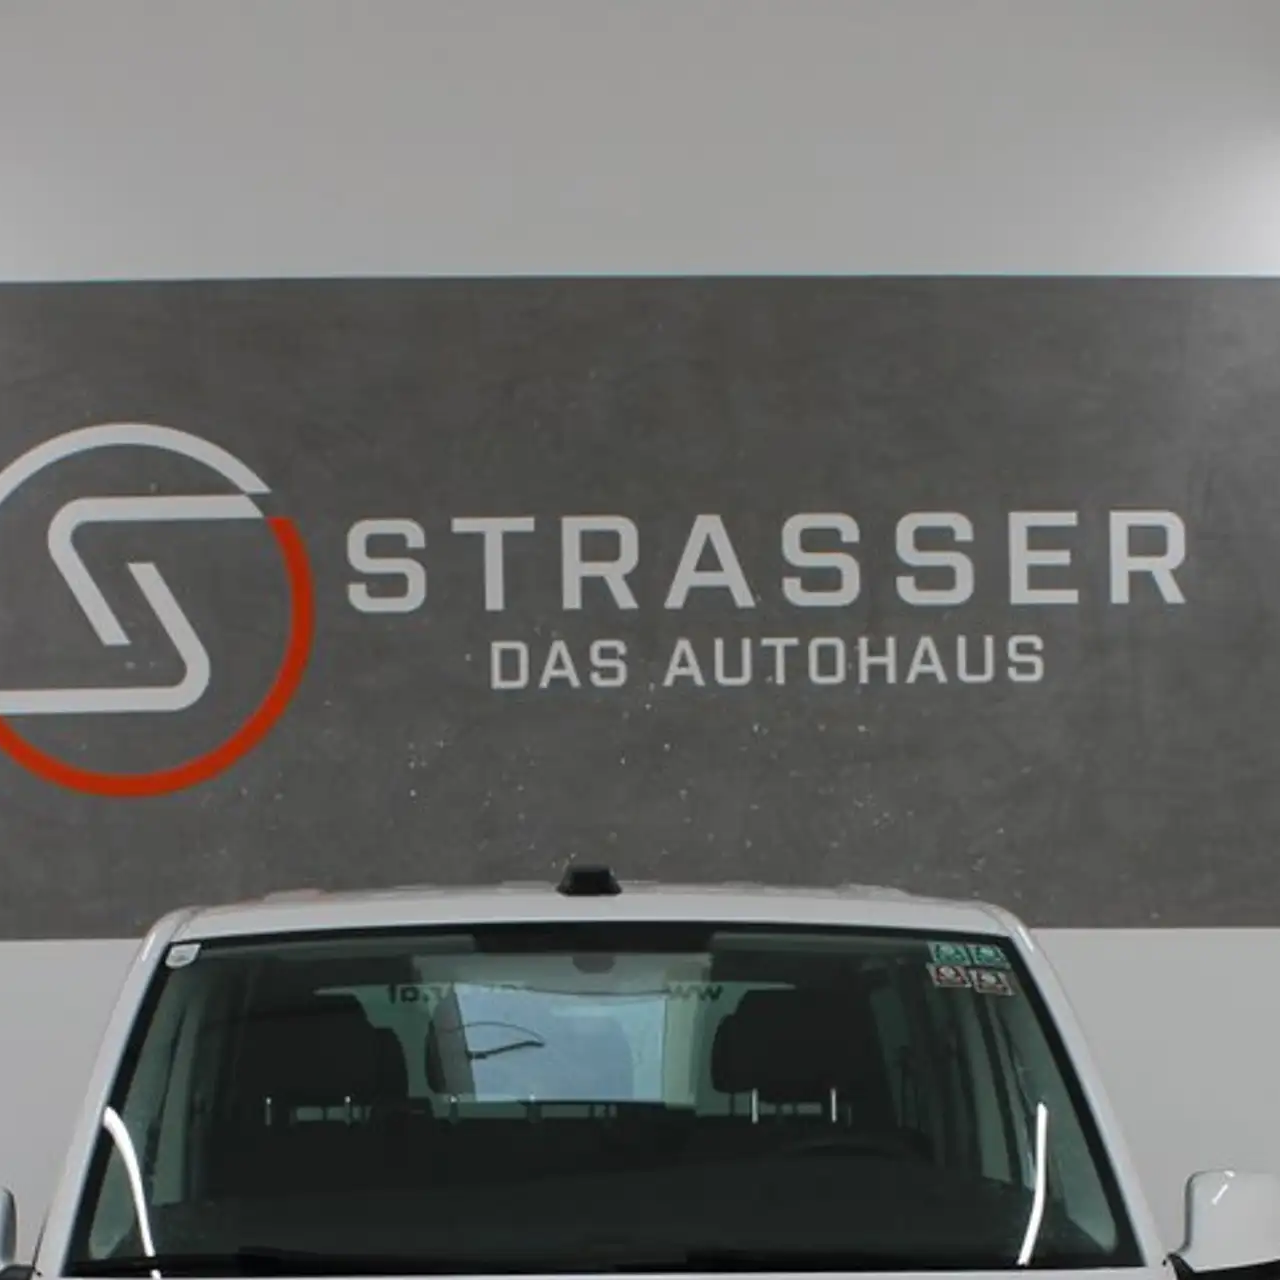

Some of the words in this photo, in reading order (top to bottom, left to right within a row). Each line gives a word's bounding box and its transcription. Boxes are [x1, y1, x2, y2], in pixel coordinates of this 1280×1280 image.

[347, 509, 1187, 613] STRASSER
[490, 639, 628, 690] DAS
[663, 634, 1045, 687] AUTOHAUS
